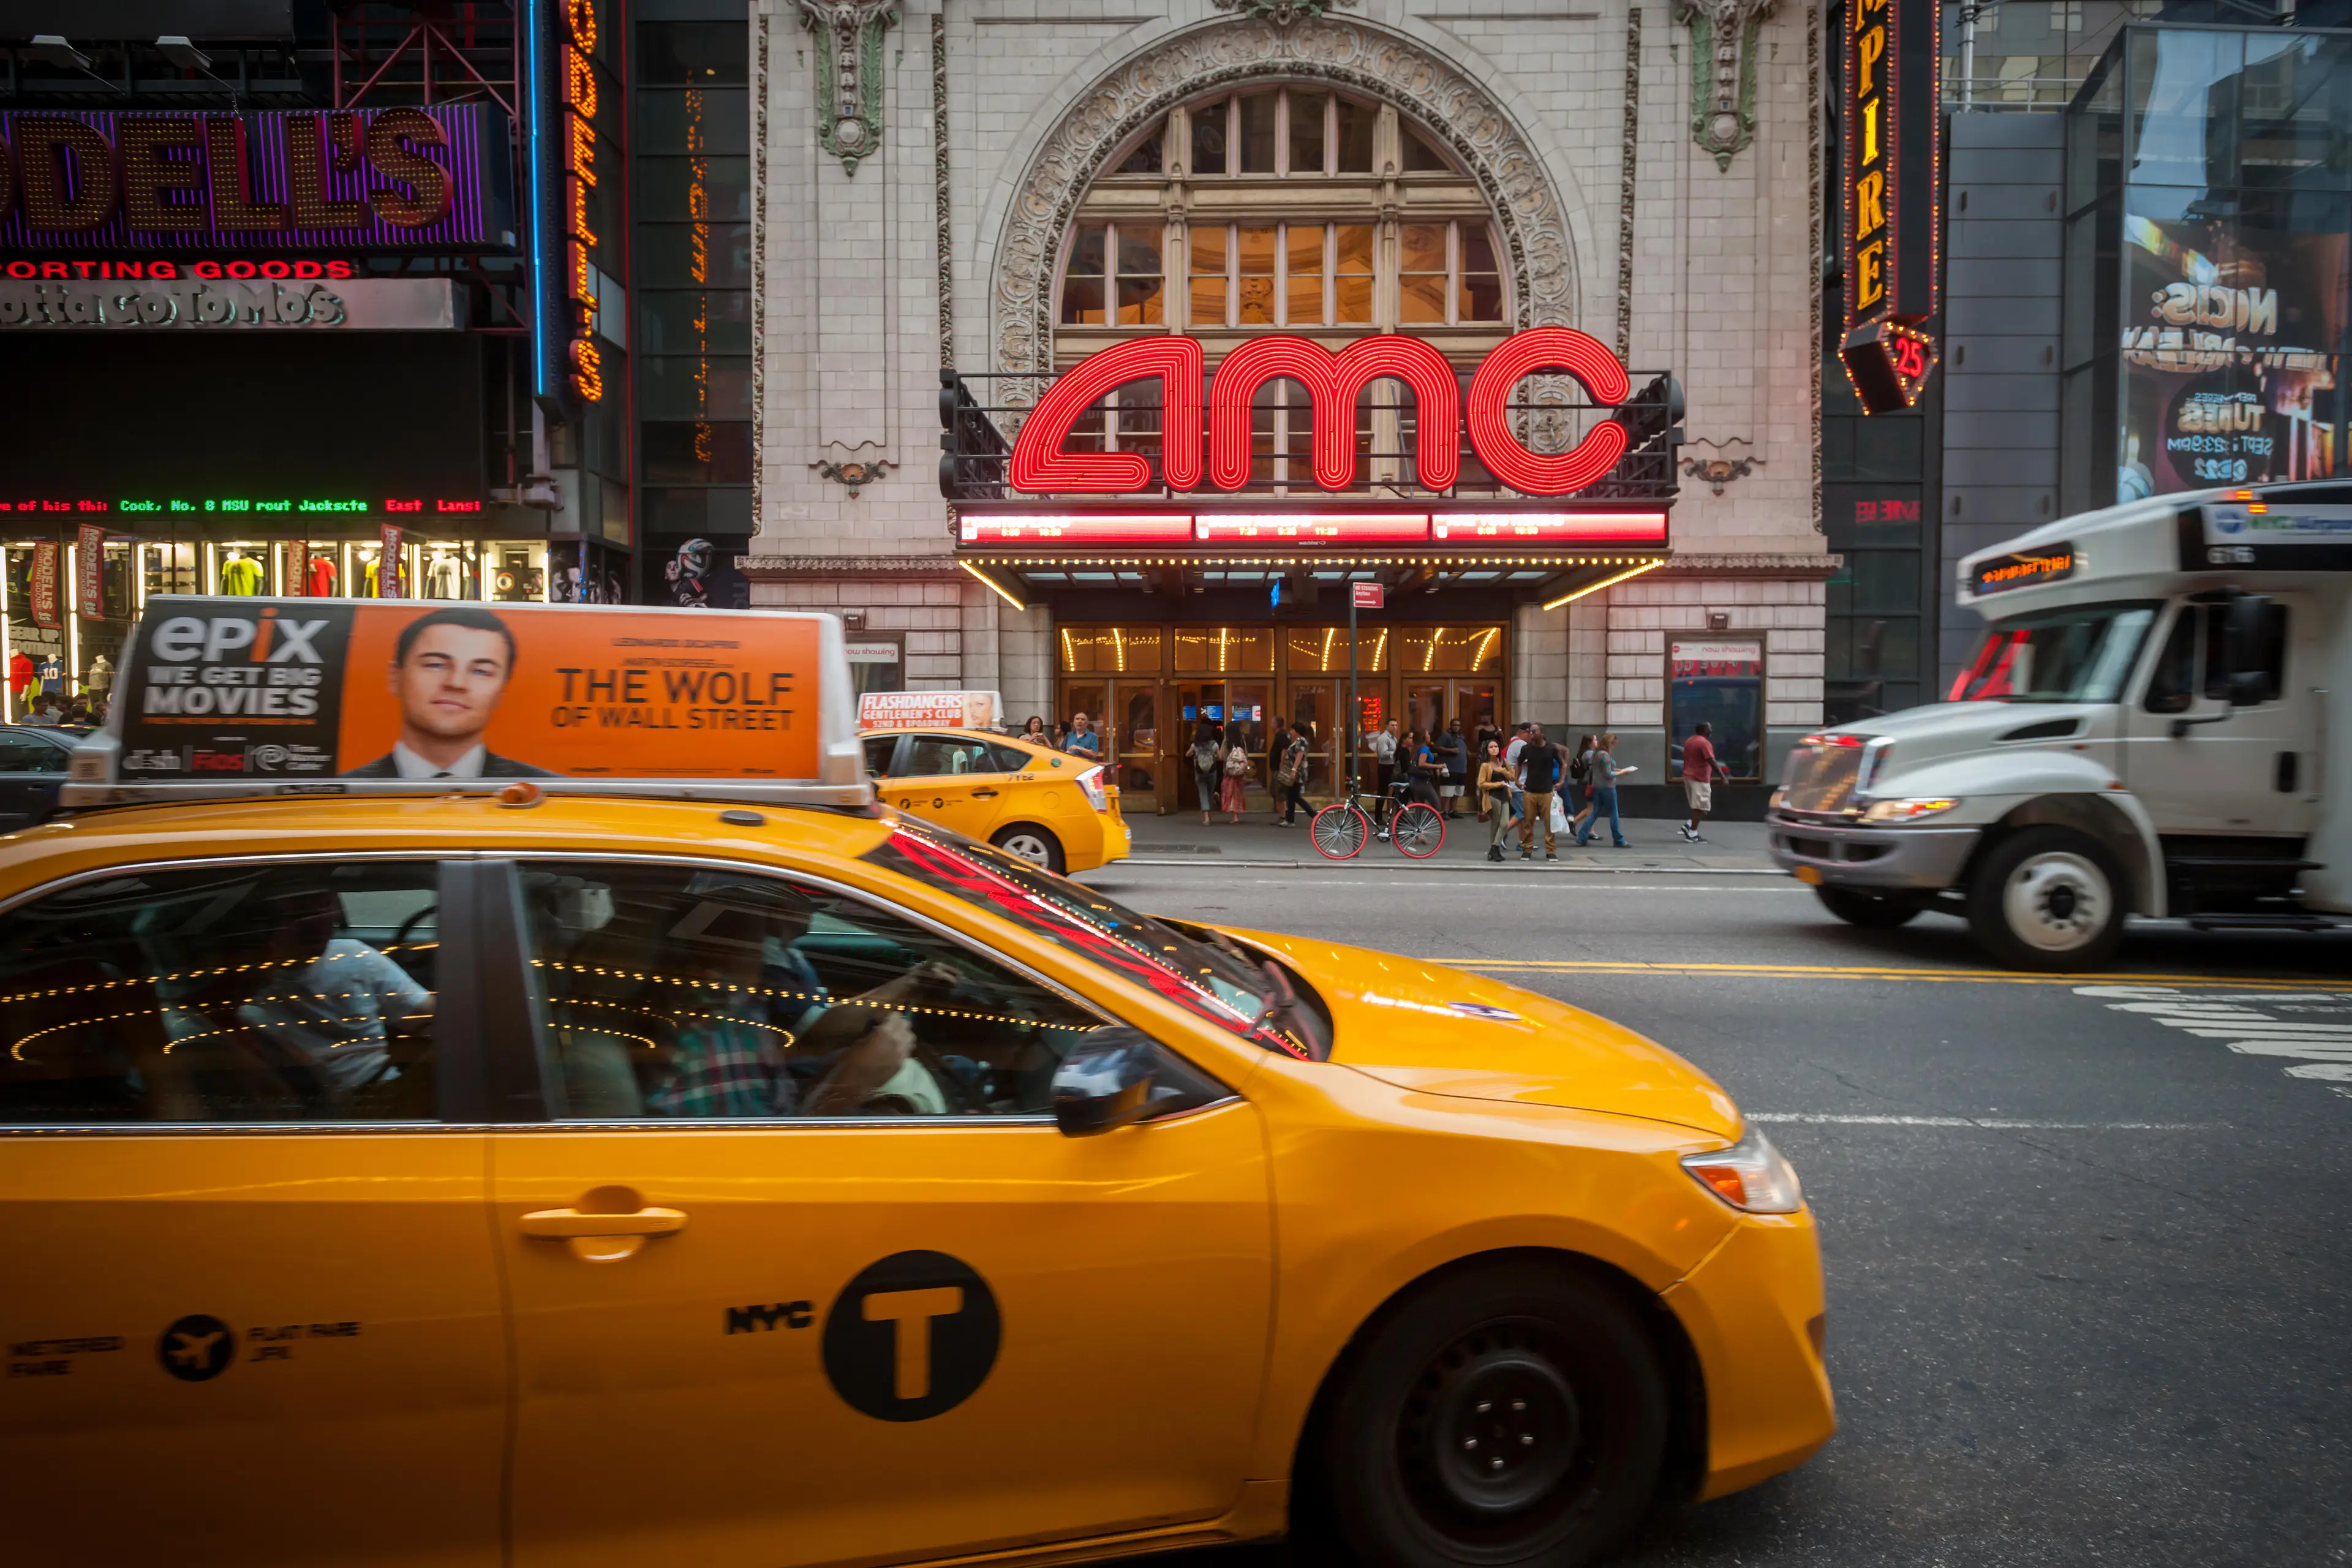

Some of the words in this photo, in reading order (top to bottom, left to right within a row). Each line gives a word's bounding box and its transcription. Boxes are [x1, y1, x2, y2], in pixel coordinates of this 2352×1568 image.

[0, 108, 453, 231] DELL'S
[0, 260, 176, 279] ORTING
[194, 260, 352, 279] GOODS
[105, 284, 175, 325] Go
[171, 284, 235, 325] To
[238, 282, 343, 325] Mo's
[1896, 336, 1923, 377] 25
[1010, 326, 1630, 495] amc
[17, 500, 37, 511] of
[42, 500, 71, 511] his
[120, 499, 162, 511] Cook,
[170, 499, 196, 511] No.
[205, 499, 216, 511] 8
[222, 499, 249, 511] MSU
[255, 499, 292, 511] rout
[385, 499, 423, 511] East
[42, 544, 55, 609] MODELL'S
[86, 528, 99, 599] MODELL'S
[862, 647, 895, 657] showing
[1722, 645, 1756, 655] showing
[43, 668, 58, 680] 10
[201, 666, 265, 685] GET
[554, 668, 650, 704] THE
[663, 671, 794, 705] WOLF
[143, 686, 320, 715] MOVIES
[864, 695, 963, 709] FLASHDANCERS
[552, 706, 592, 728] OF
[596, 707, 679, 729] WALL
[687, 708, 794, 730] STREET
[862, 709, 933, 720] GENTLEMEN'S
[935, 709, 962, 718] CLUB
[725, 1299, 815, 1335] NYC
[862, 1286, 965, 1400] T
